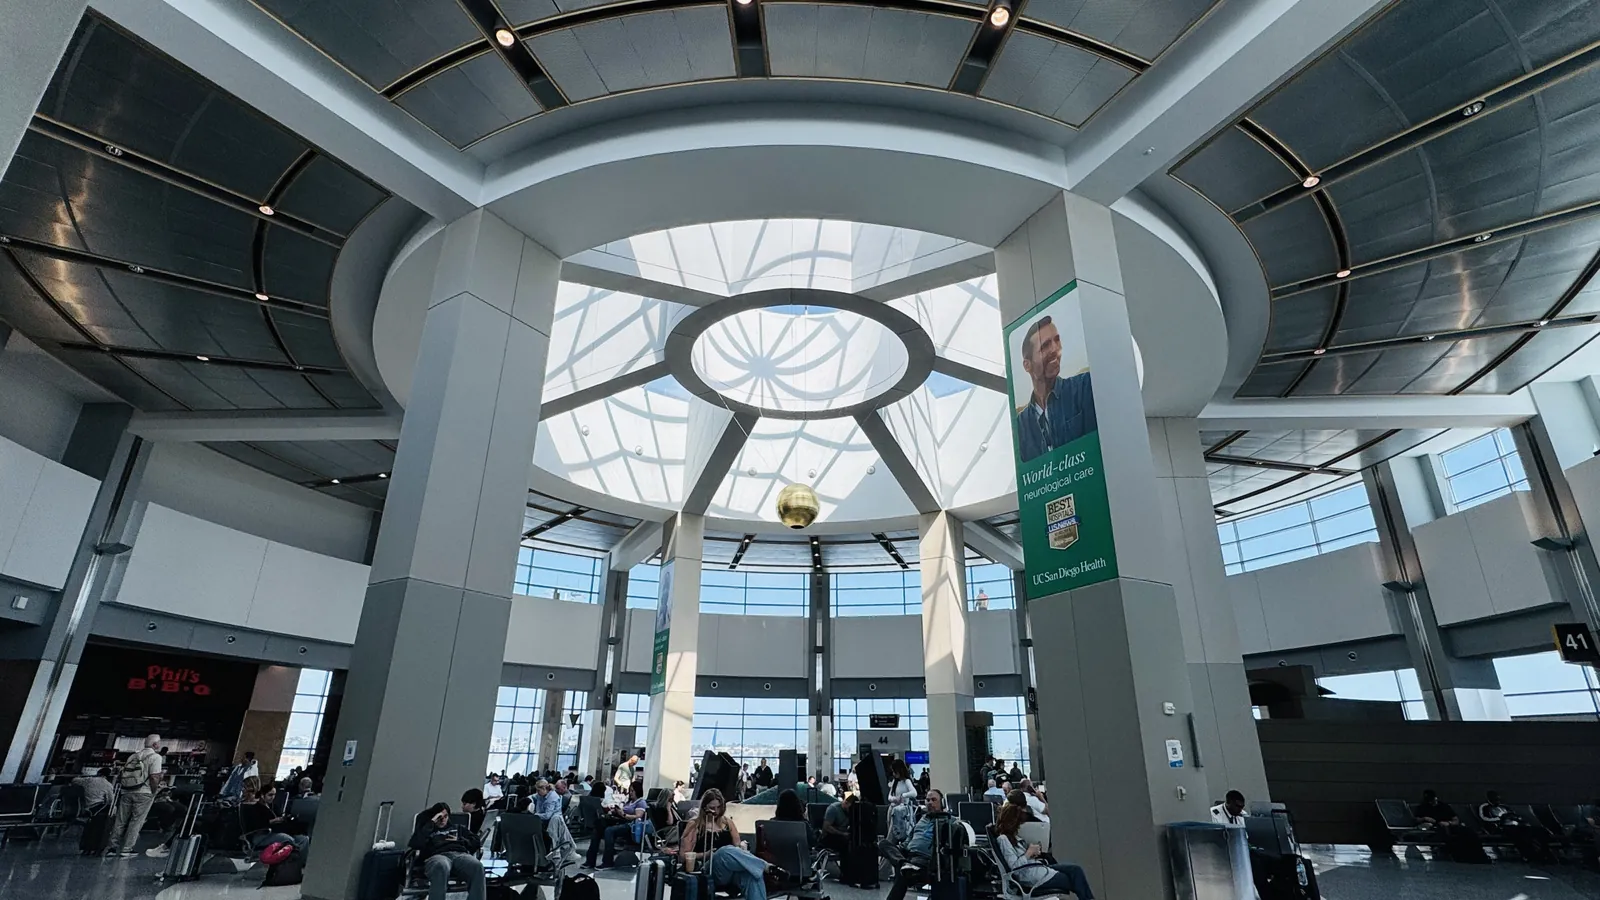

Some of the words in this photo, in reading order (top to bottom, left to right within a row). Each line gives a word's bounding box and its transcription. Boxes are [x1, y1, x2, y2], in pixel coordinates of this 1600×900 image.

[1022, 451, 1086, 486] World-class
[1024, 474, 1072, 502] neurological
[1073, 466, 1094, 481] care
[1047, 497, 1072, 515] BEST
[1032, 573, 1045, 585] UC
[1045, 571, 1058, 583] San
[1058, 566, 1080, 577] Diego
[1080, 557, 1106, 572] Health
[1566, 633, 1588, 650] 41
[147, 665, 200, 684] Phil's
[878, 736, 888, 744] 44
